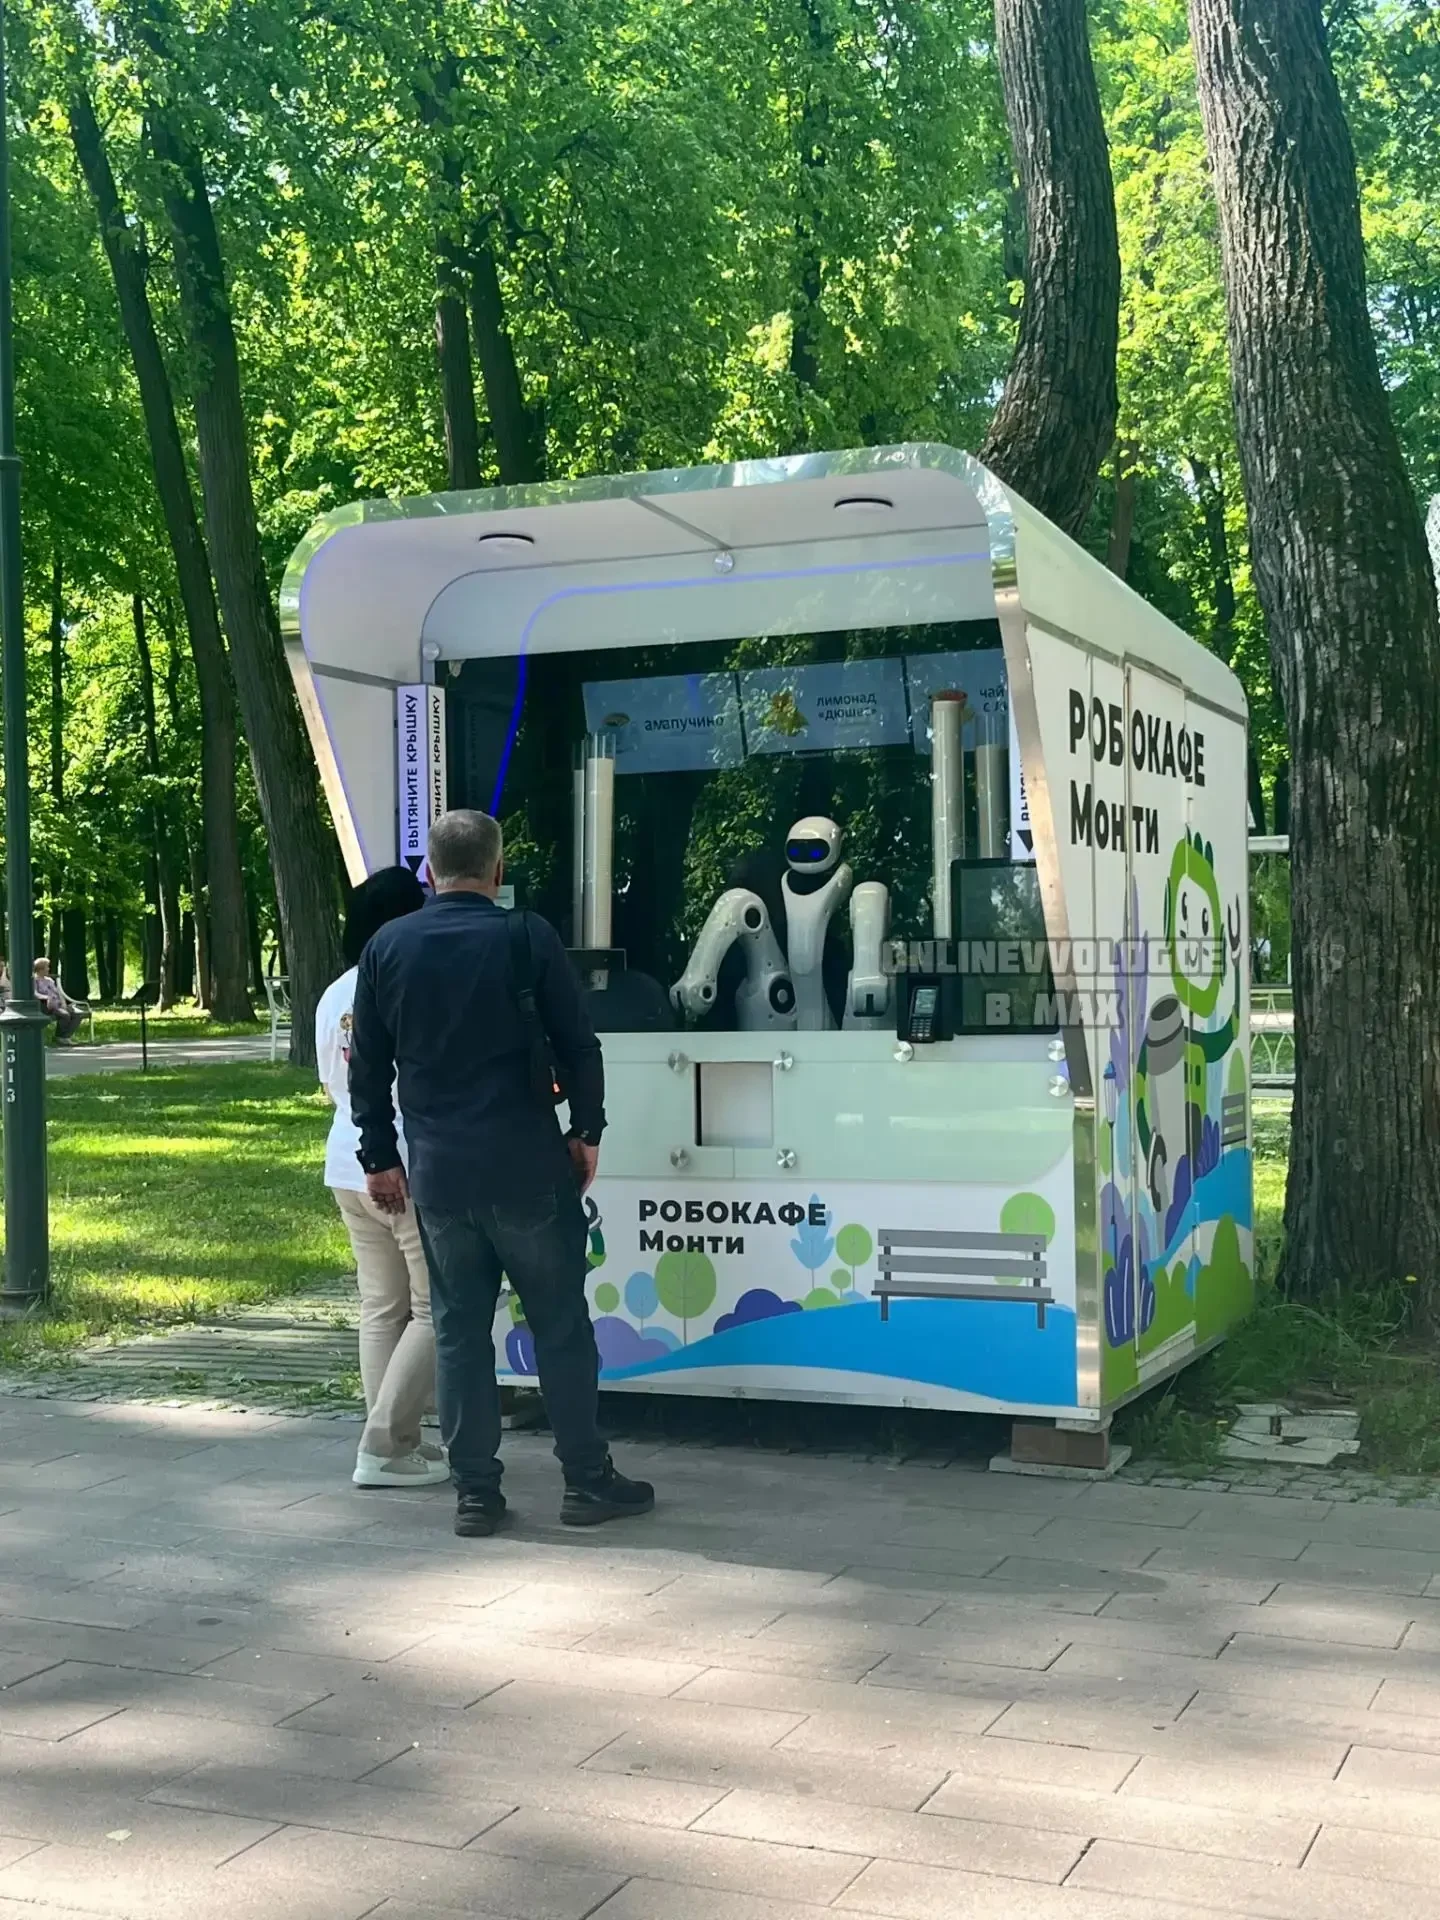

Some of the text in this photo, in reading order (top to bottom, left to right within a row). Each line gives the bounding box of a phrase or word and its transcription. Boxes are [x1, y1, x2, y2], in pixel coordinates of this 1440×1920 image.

[816, 692, 877, 706] лимонад
[432, 695, 442, 821] ЯНИТЕ КРЫШКУ
[1069, 687, 1206, 788] РОБОКАФЕ
[405, 694, 419, 848] ВЫТЯНИТЕ КРЫШКУ
[638, 1199, 827, 1227] РОБОКАФЕ
[639, 1229, 745, 1255] Монти
